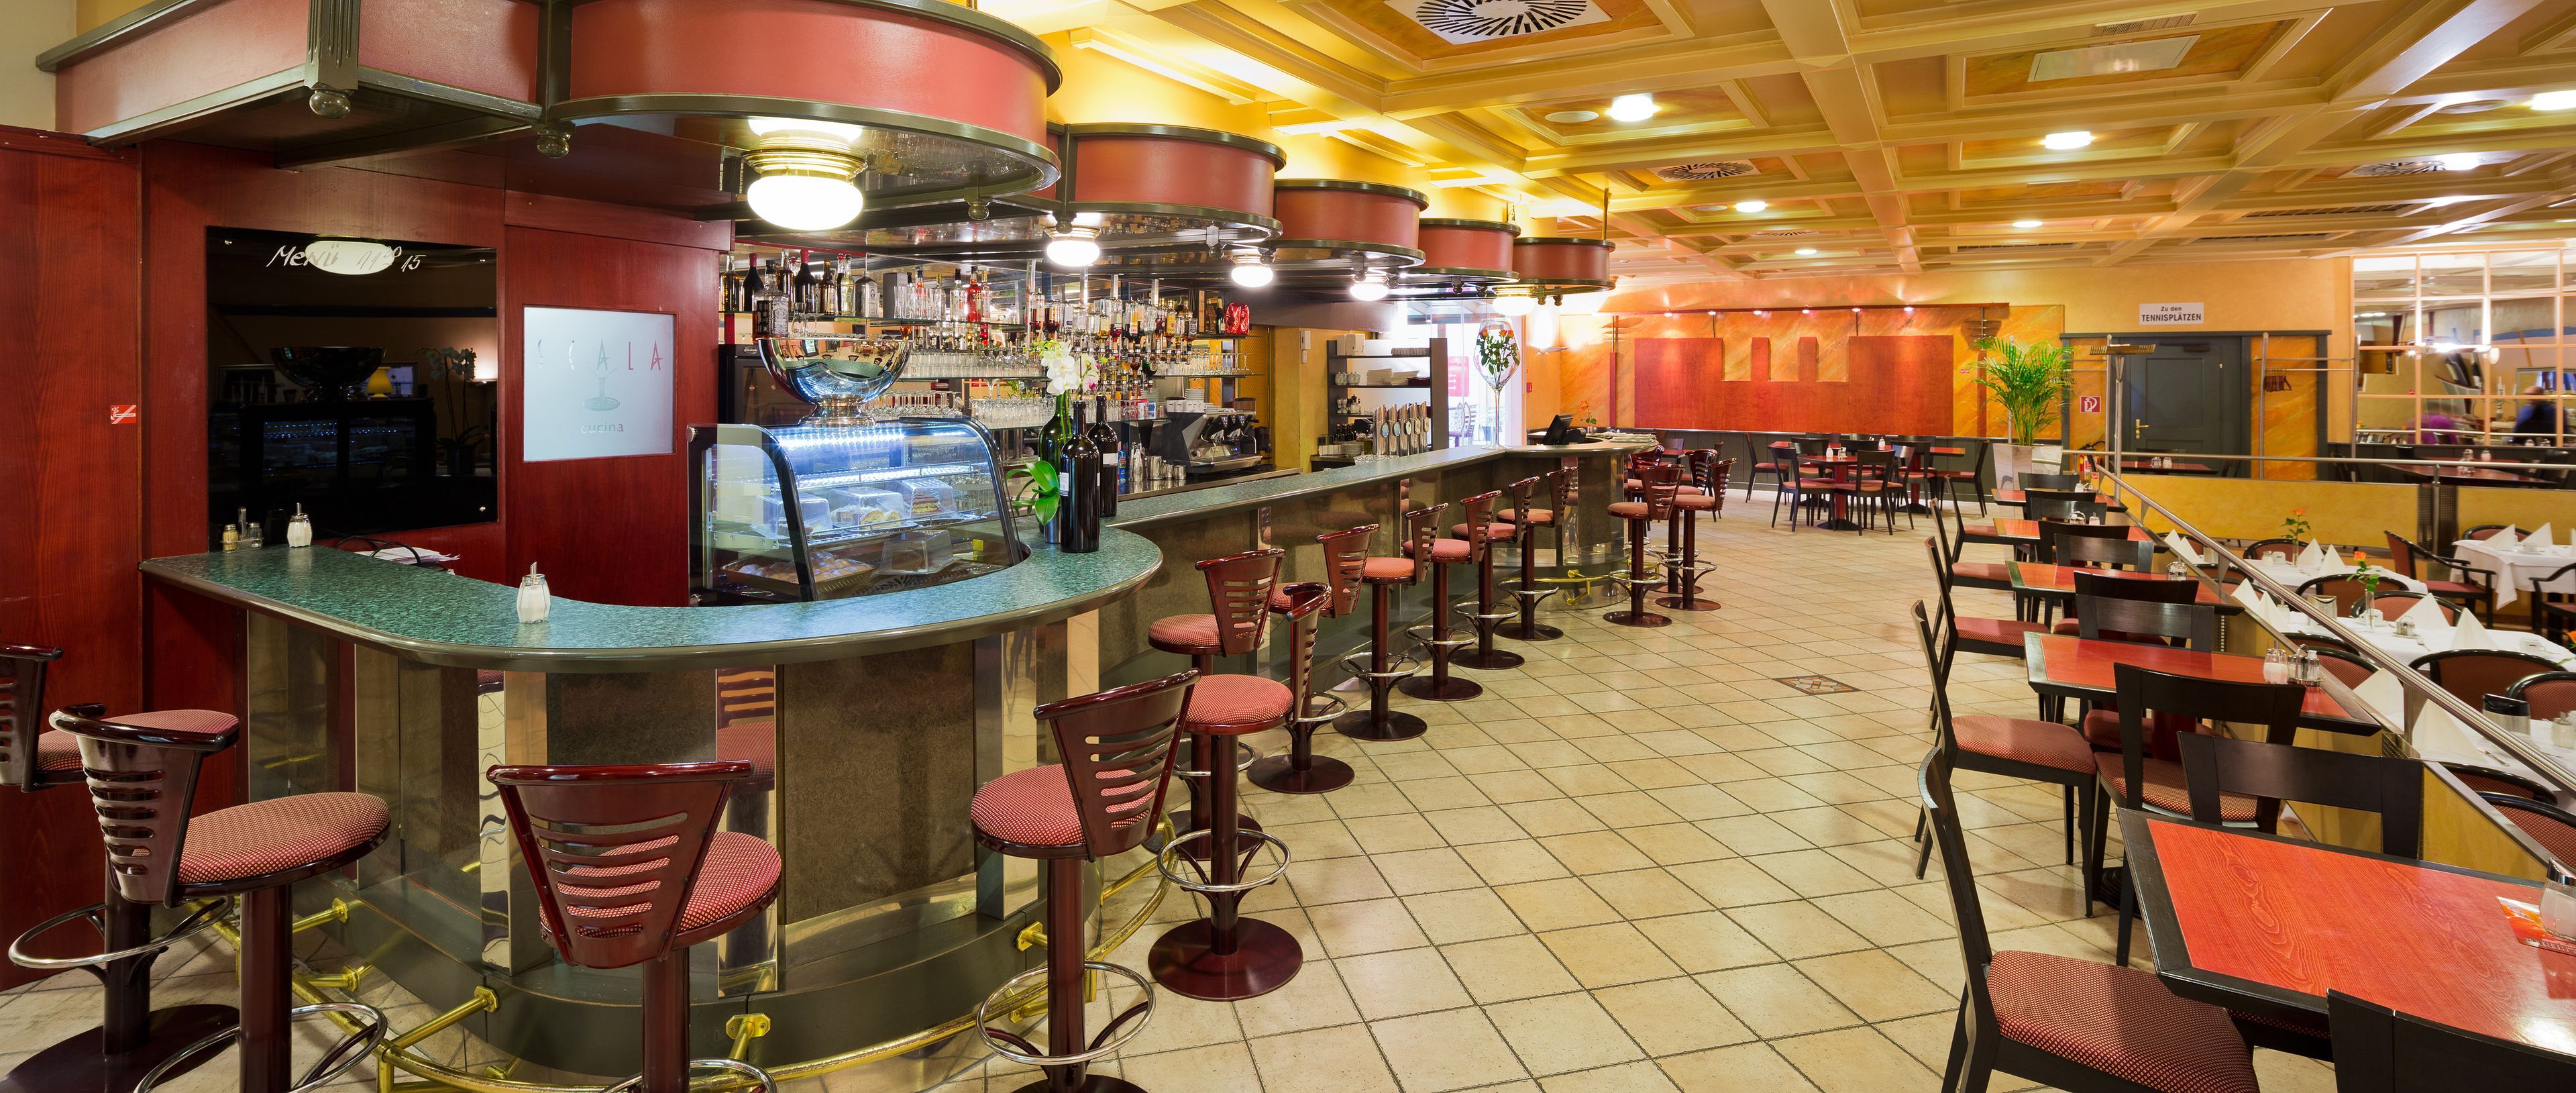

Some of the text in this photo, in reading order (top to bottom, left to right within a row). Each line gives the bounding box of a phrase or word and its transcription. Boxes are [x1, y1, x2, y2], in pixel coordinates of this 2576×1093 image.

[401, 254, 427, 272] 15
[2141, 313, 2202, 322] TENNISPLÄTZEN
[580, 422, 625, 433] cucina
